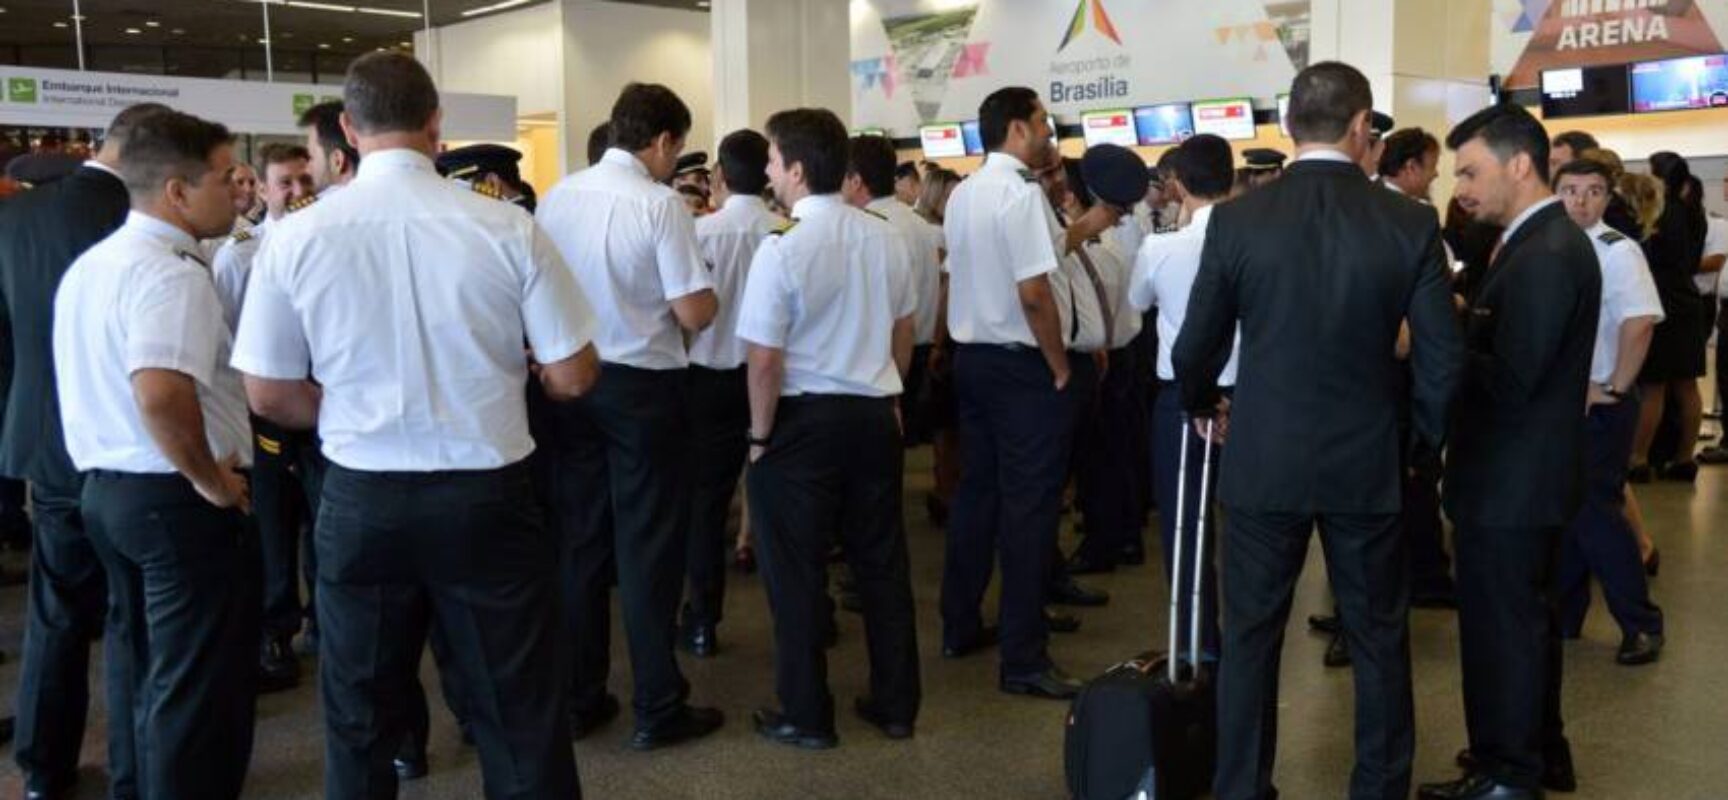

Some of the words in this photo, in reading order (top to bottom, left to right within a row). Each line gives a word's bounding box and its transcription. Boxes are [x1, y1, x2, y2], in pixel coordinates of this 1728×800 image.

[1557, 14, 1669, 50] ARENA
[42, 80, 102, 94] Embarque
[106, 83, 179, 97] Internacional
[1050, 74, 1128, 102] Brasília
